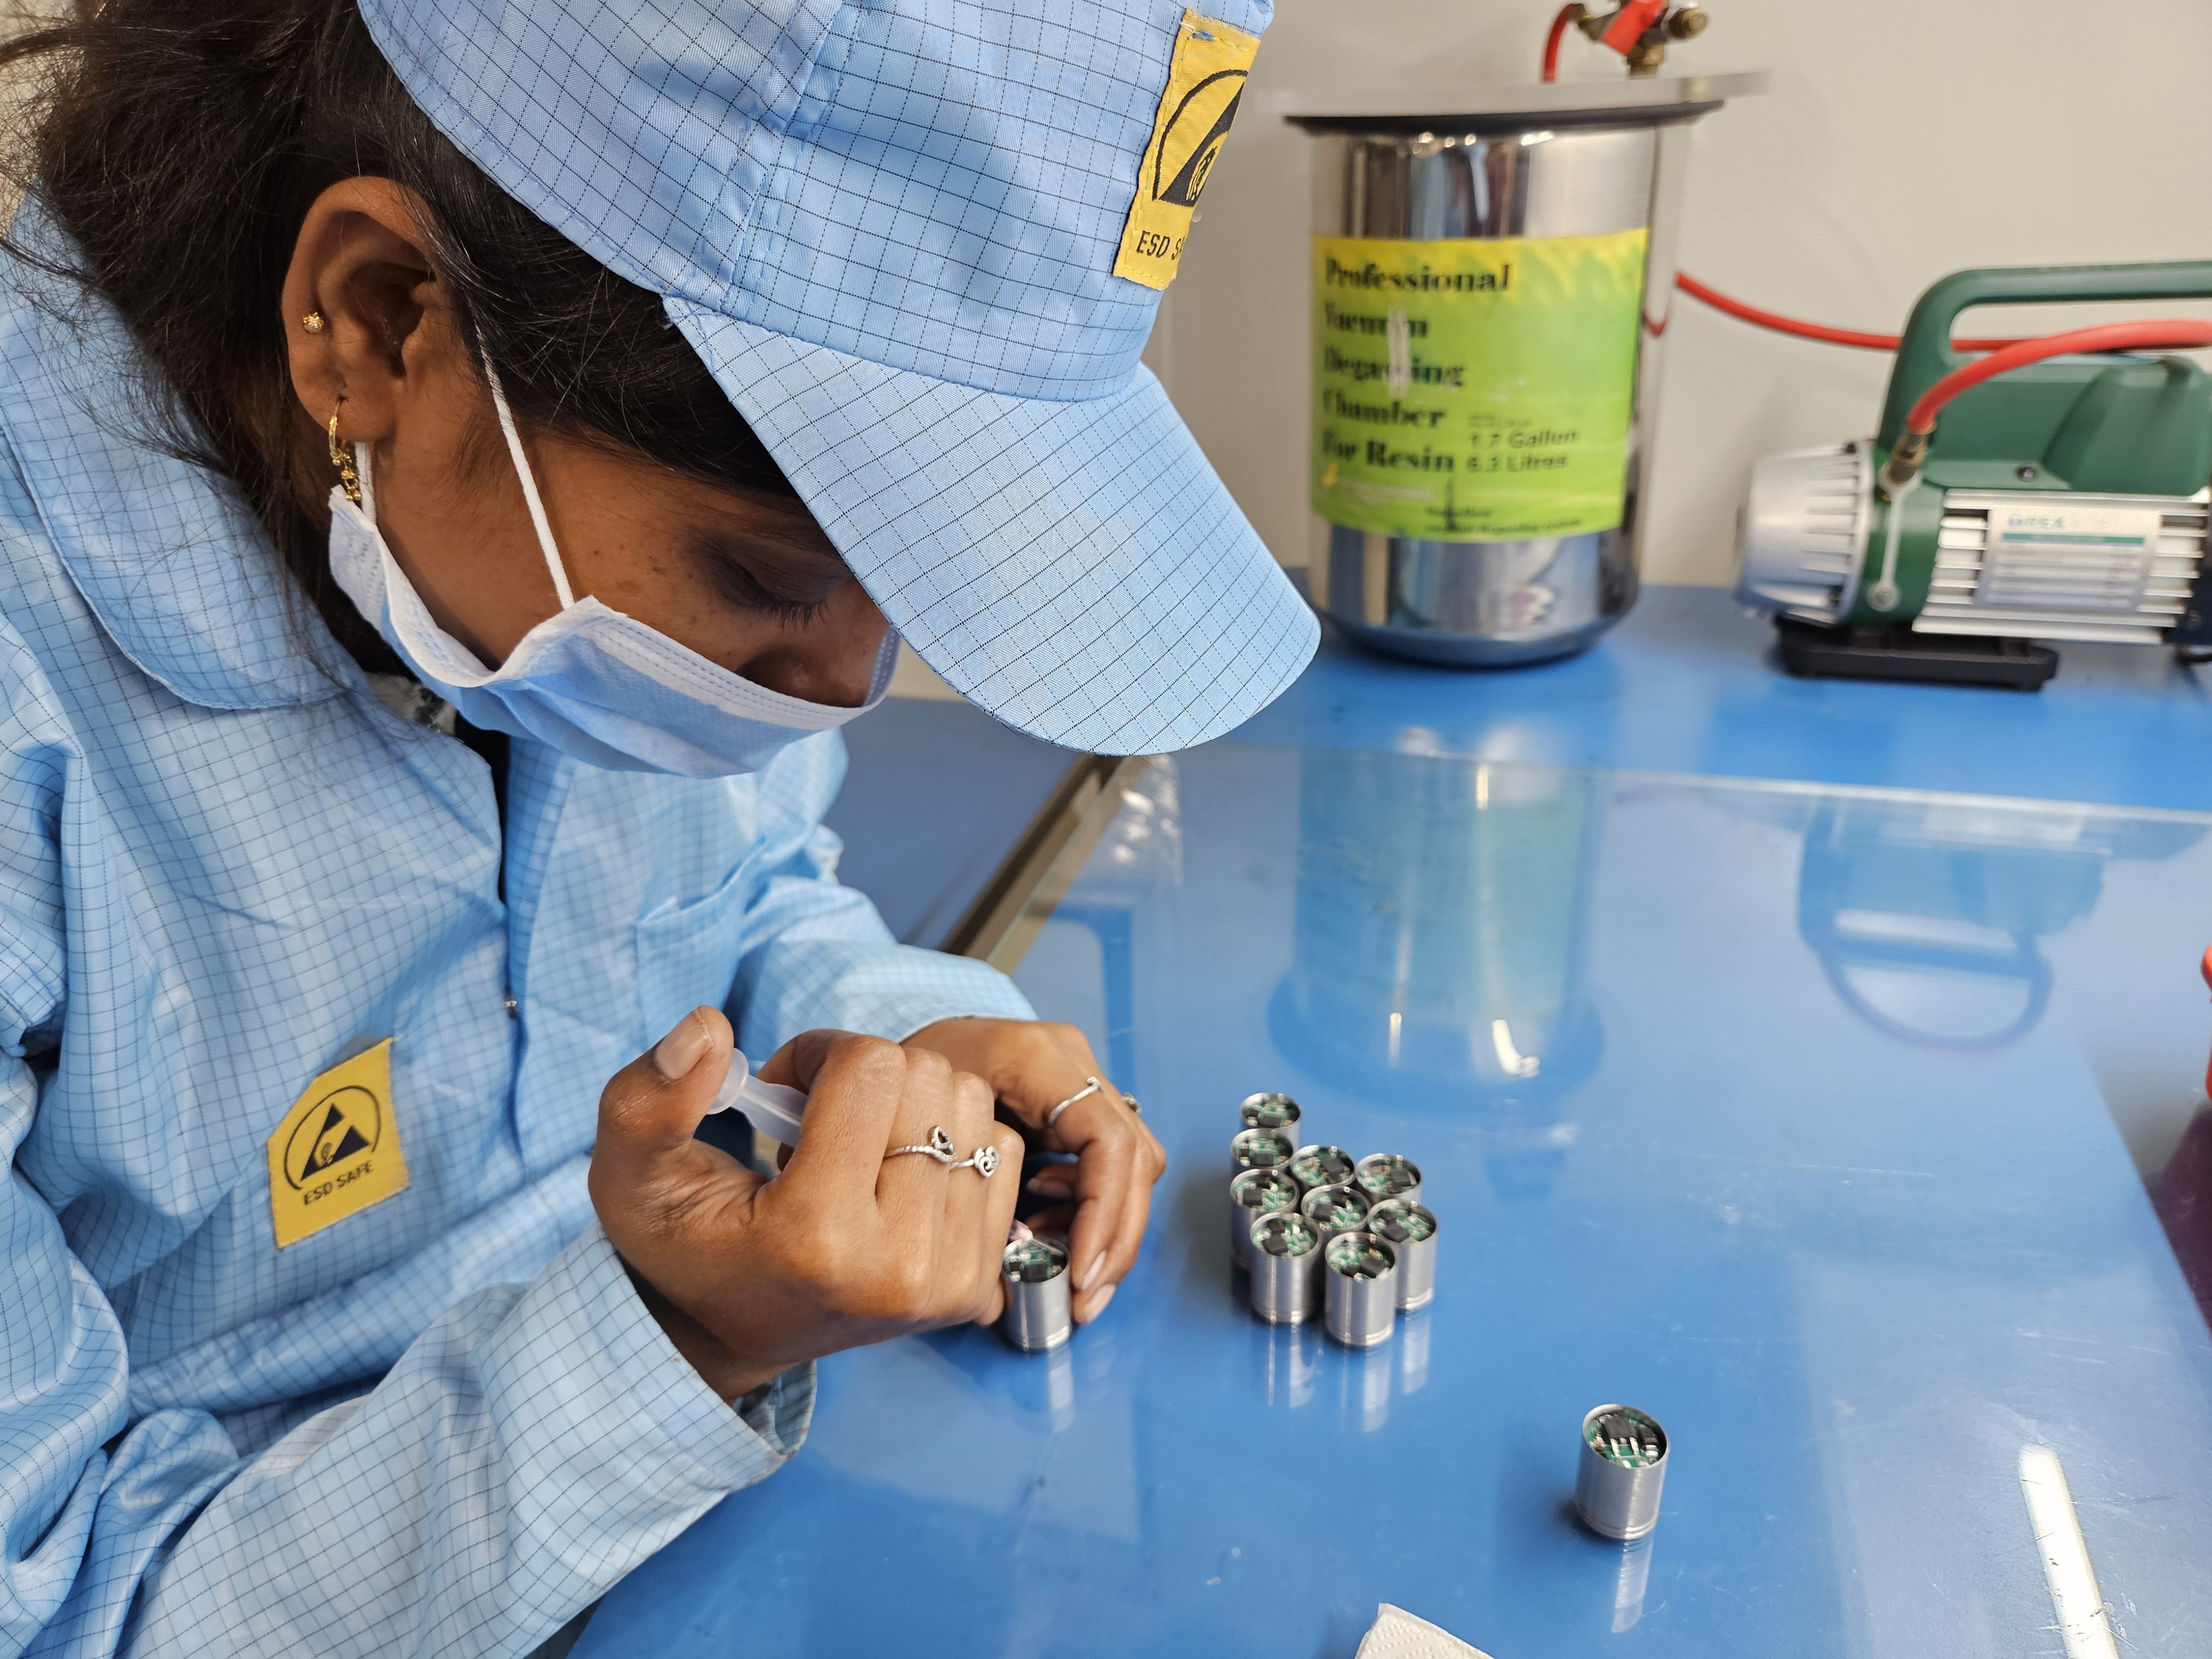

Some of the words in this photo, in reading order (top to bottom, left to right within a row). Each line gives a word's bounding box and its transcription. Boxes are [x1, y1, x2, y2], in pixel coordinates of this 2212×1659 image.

[1136, 230, 1171, 258] ESD
[1325, 258, 1511, 292] Professional
[1323, 388, 1446, 428] Chamber
[1508, 429, 1578, 449] Gallon
[1366, 440, 1454, 471] Resin
[1506, 455, 1567, 472] Litres
[304, 1182, 333, 1205] ESD
[336, 1160, 375, 1188] SAFE
